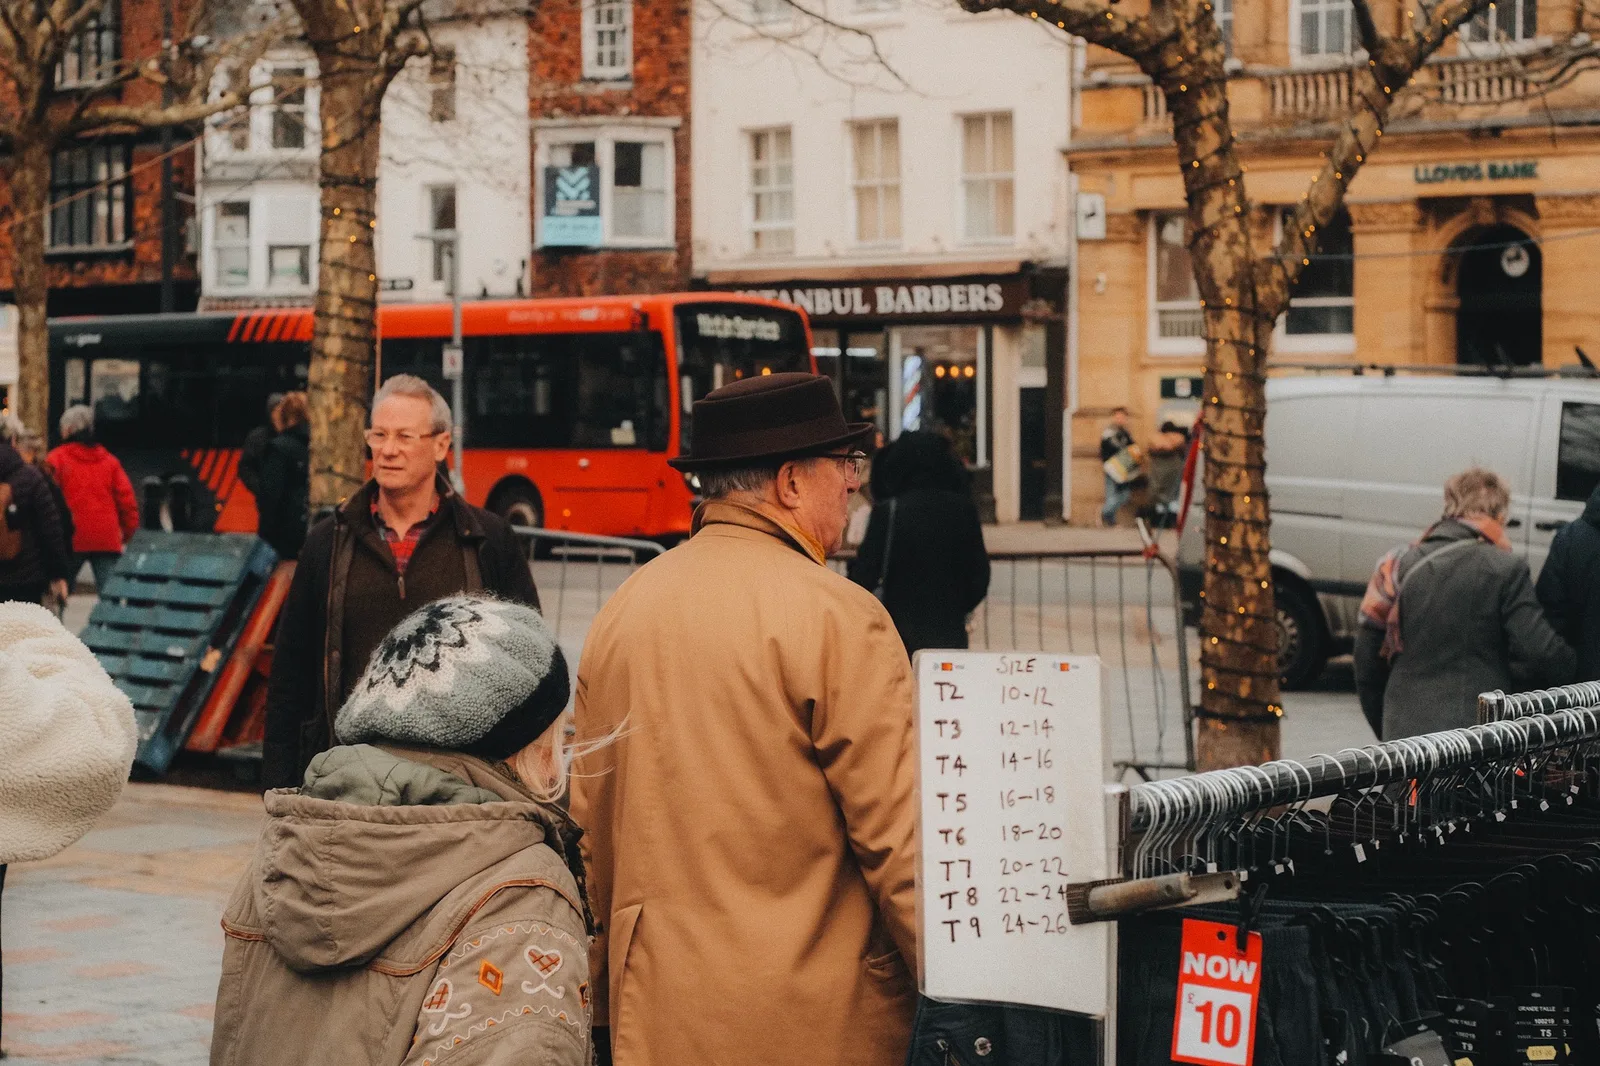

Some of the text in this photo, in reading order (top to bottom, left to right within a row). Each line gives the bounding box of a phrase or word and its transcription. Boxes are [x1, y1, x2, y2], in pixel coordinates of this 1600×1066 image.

[1487, 161, 1538, 180] BANK
[876, 283, 1004, 314] BARBERS
[996, 656, 1036, 675] SIZE
[934, 682, 964, 702] T2
[934, 719, 962, 739] T3
[936, 755, 967, 776] T4
[936, 793, 967, 812] T5
[939, 827, 965, 846] T6
[940, 859, 971, 881] T7
[940, 887, 977, 910] T8
[942, 917, 981, 942] T9
[1183, 951, 1257, 985] NOW
